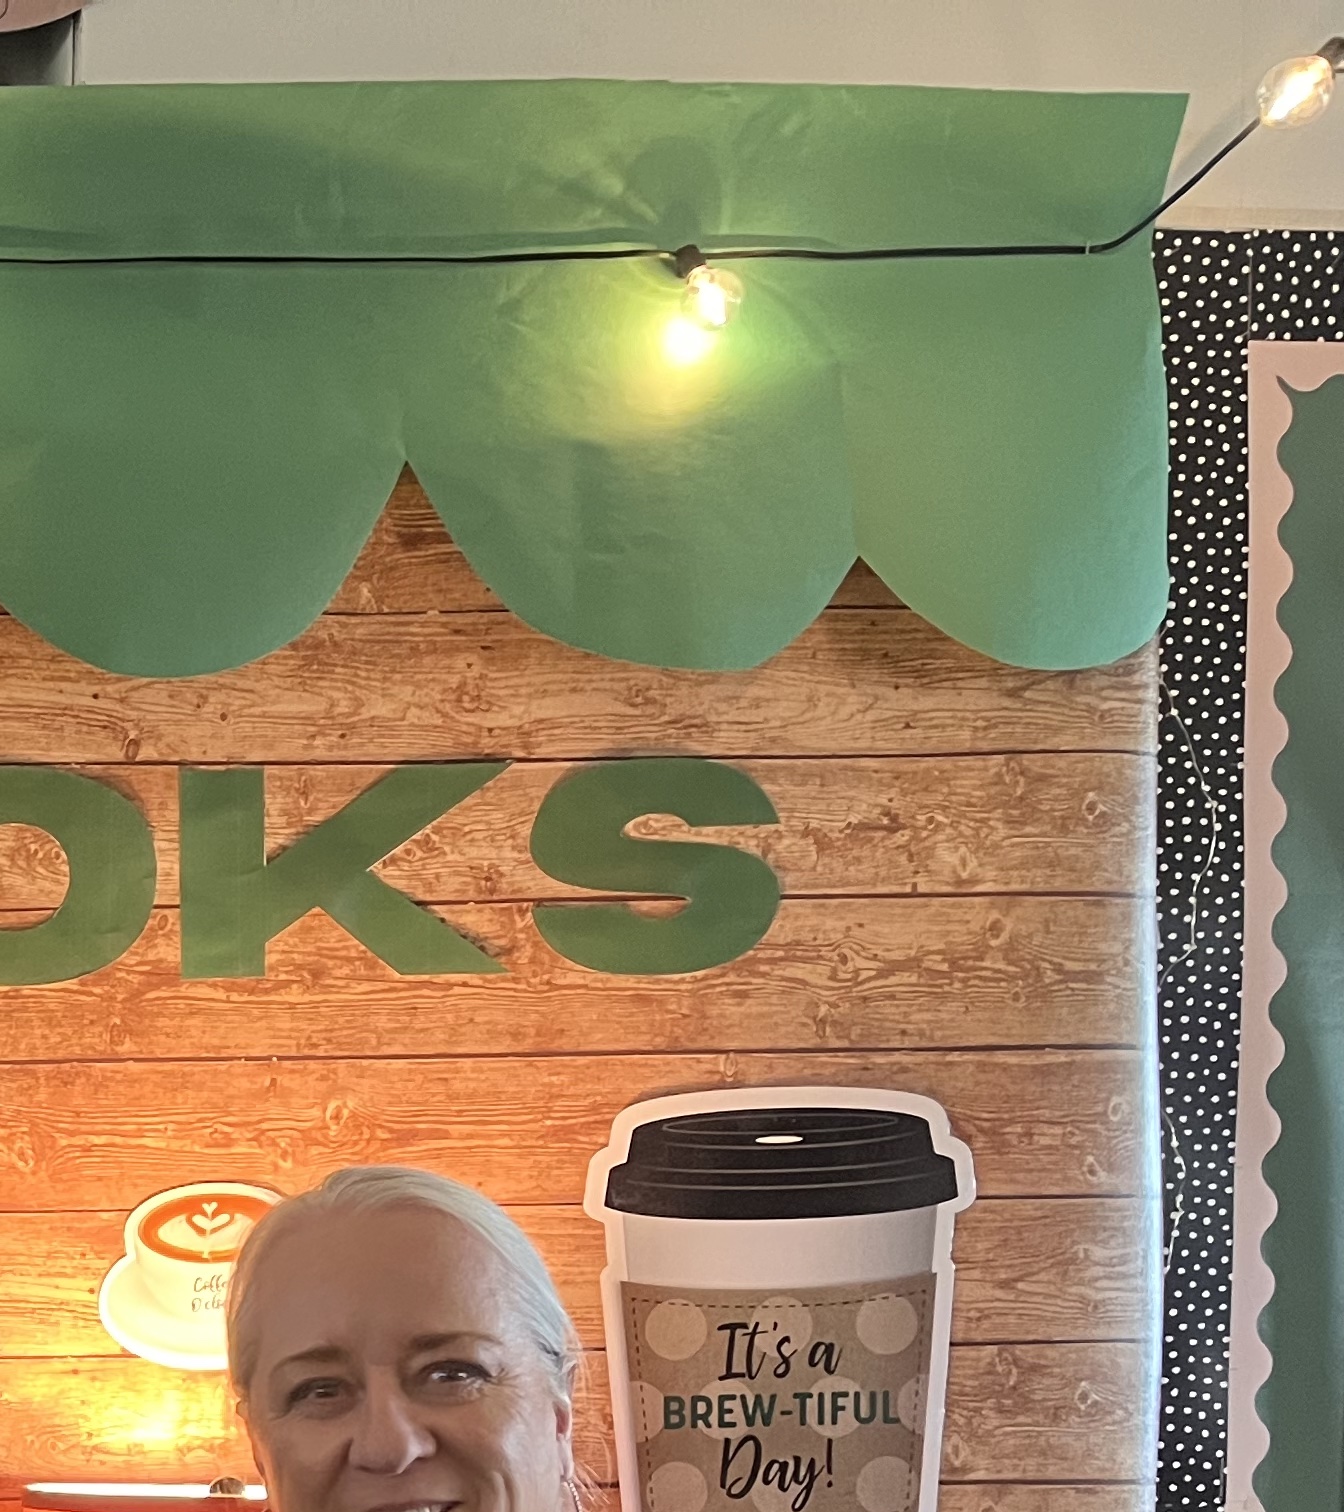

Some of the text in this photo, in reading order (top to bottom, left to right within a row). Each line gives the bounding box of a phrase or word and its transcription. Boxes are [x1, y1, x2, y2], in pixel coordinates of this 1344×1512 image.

[717, 1321, 842, 1381] It's a
[663, 1390, 900, 1429] BREW-TIFUL
[719, 1434, 833, 1512] Day!
